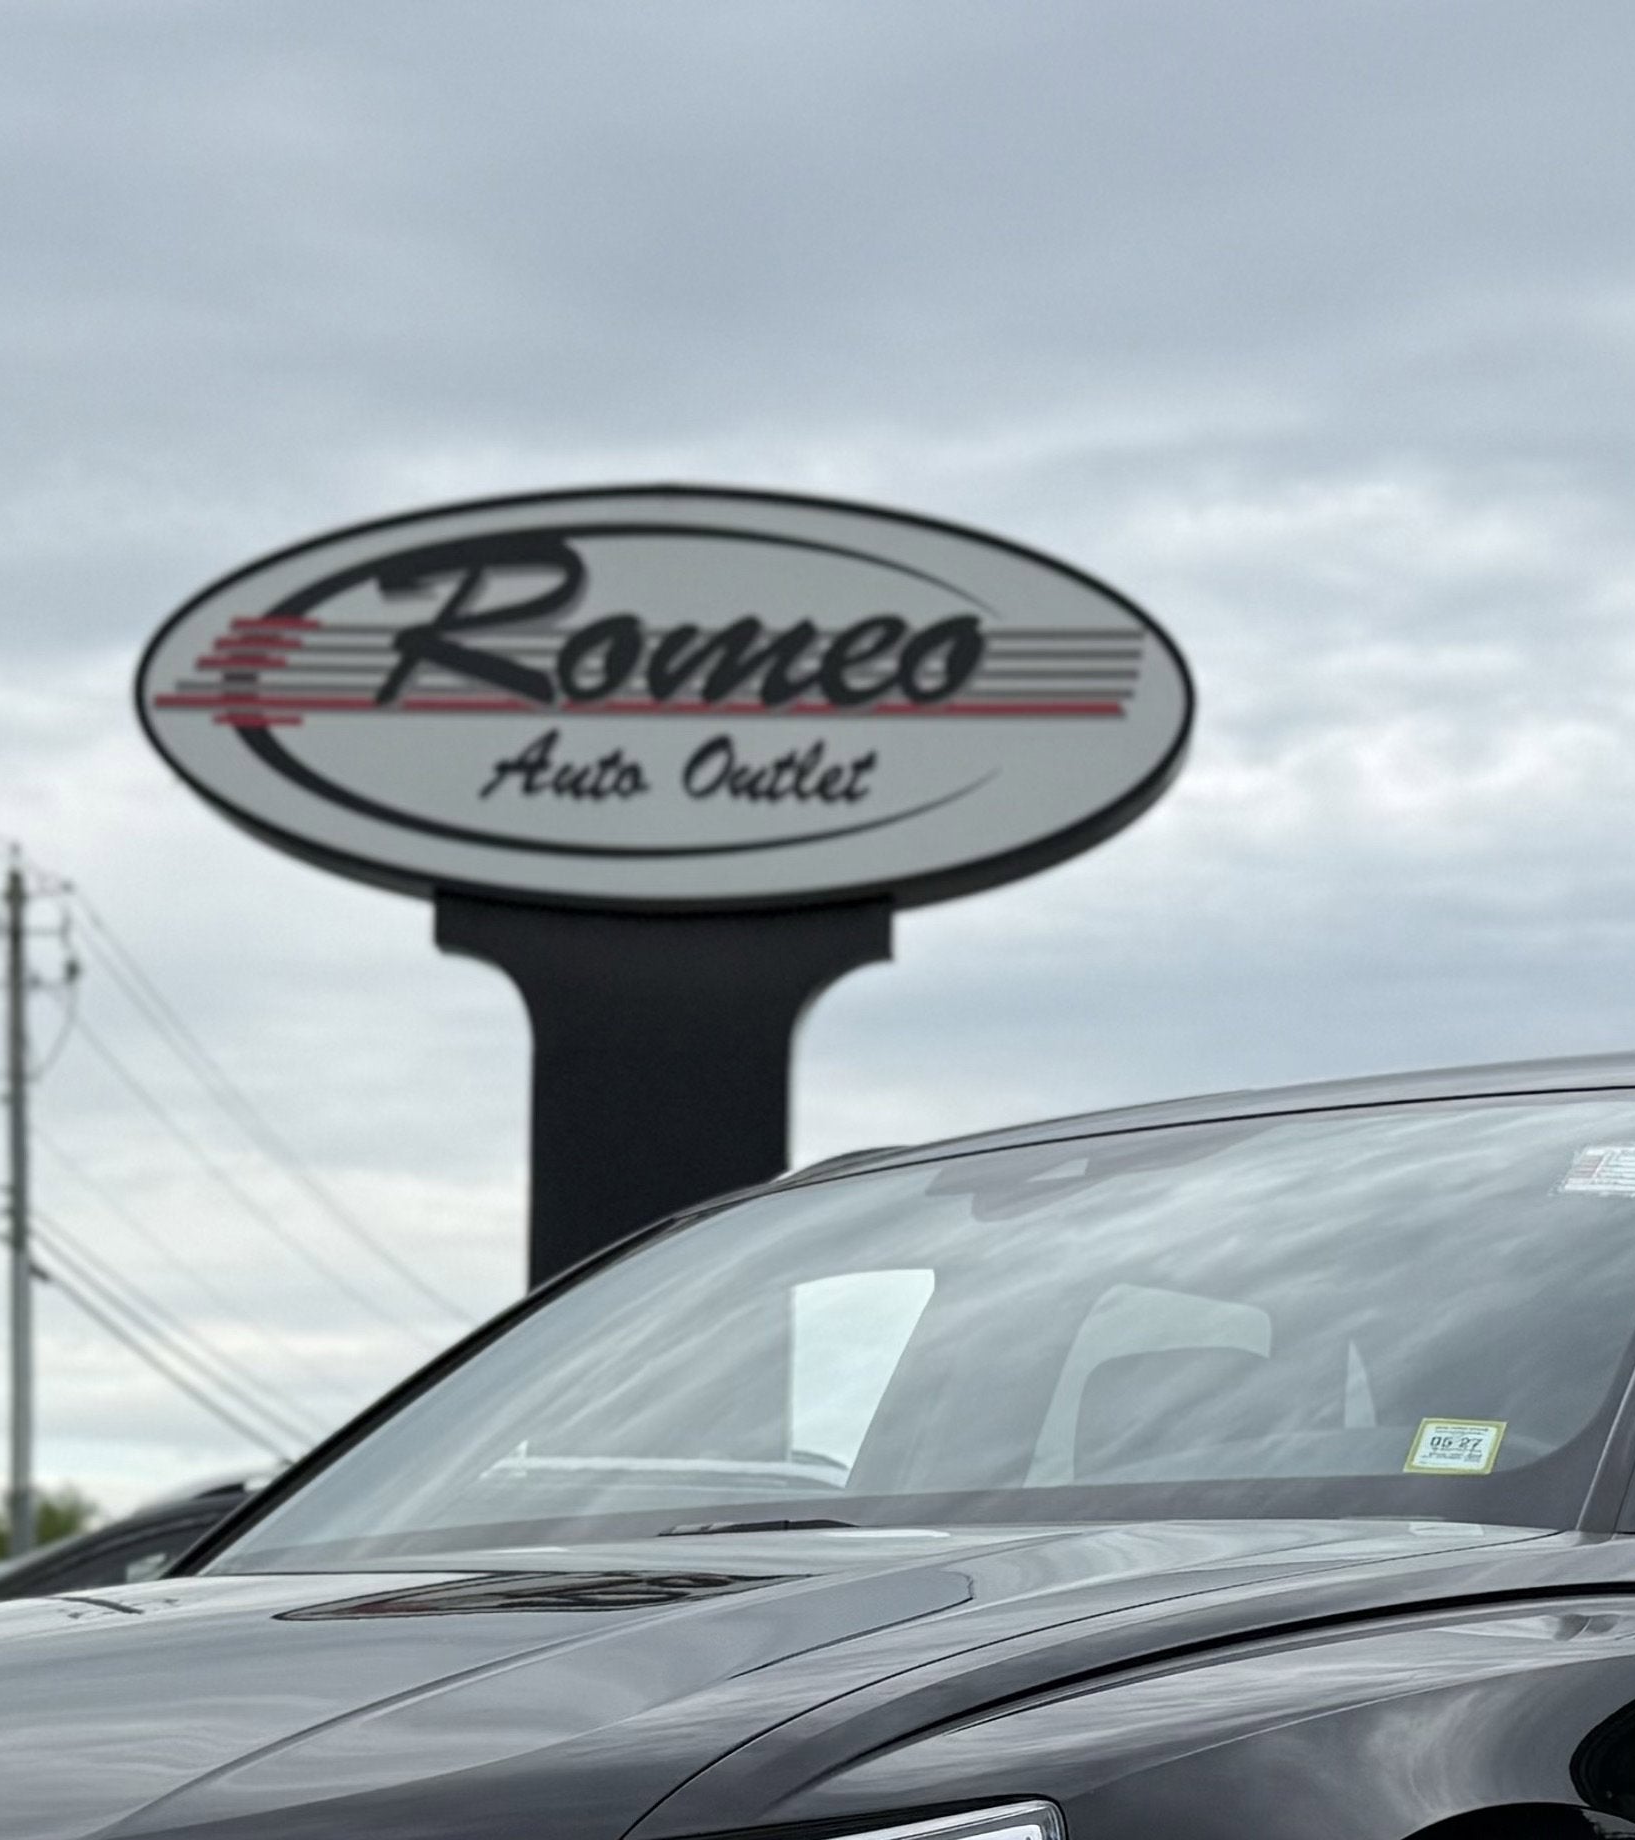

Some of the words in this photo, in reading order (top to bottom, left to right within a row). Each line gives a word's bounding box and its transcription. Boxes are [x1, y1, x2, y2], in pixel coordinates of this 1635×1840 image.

[374, 532, 991, 708] Romeo
[479, 729, 650, 803] Auto
[680, 733, 880, 803] Outlet
